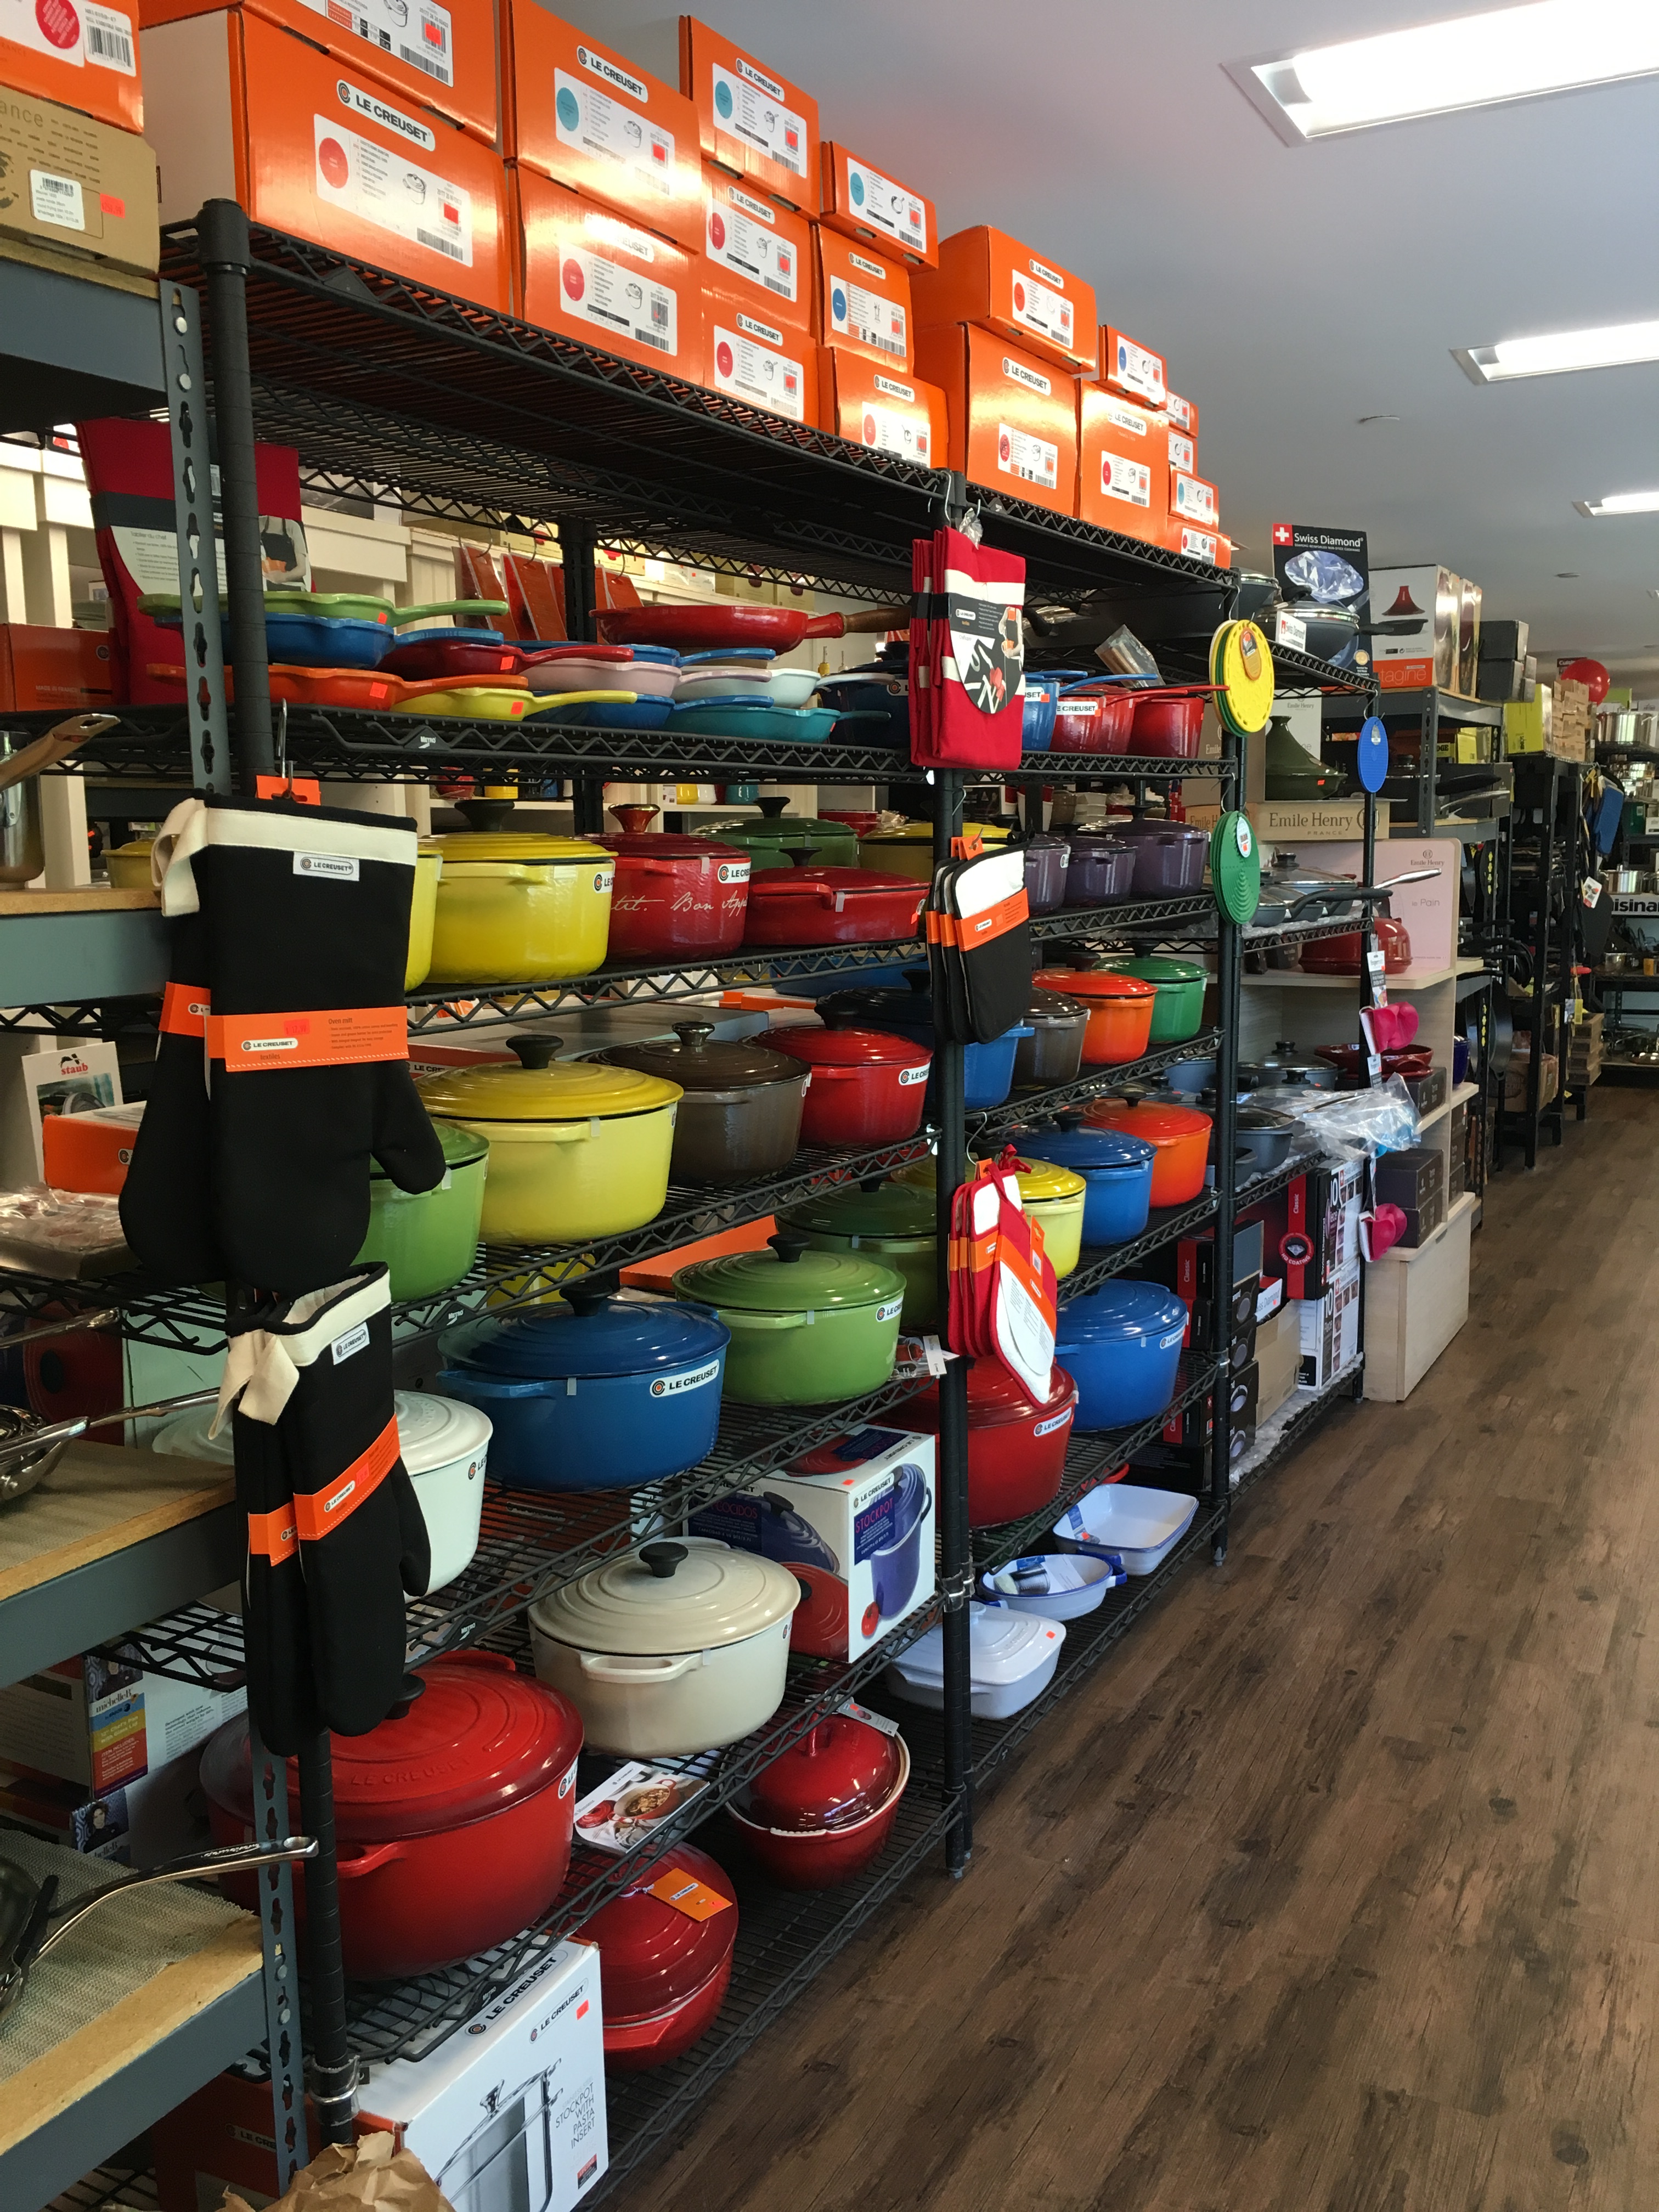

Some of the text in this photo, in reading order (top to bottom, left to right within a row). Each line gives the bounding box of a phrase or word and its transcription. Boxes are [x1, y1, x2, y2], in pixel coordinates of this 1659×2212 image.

[591, 57, 642, 95] LE CREUSET
[745, 67, 781, 97] LE CREUSET
[356, 94, 427, 142] LE CREUSET
[736, 193, 771, 219] LE CREUSET
[856, 257, 883, 275] LE CREUSET
[1036, 265, 1061, 285] LE CREUSET
[745, 320, 779, 341] LE CREUSET
[1012, 365, 1047, 390] LE CREUSET
[882, 380, 911, 398] LE CREUSET
[1115, 413, 1143, 431] LE CREUSET
[1294, 533, 1361, 548] Swiss Diamond
[1380, 668, 1426, 685] tagine
[420, 736, 436, 744] METRO
[1206, 744, 1221, 754] Emile
[1190, 815, 1211, 828] Emile
[1269, 812, 1353, 831] Emile Henry
[322, 863, 348, 871] CREUSET
[604, 878, 610, 887] LE
[670, 891, 714, 912] Bon
[1420, 898, 1440, 907] Pain
[1614, 898, 1659, 912] isina
[61, 1062, 88, 1075] staub
[1281, 1253, 1311, 1265] HD COATING
[887, 1307, 894, 1316] LE
[1325, 1288, 1333, 1318] 10
[448, 1310, 464, 1319] METRO
[348, 1335, 364, 1347] CREUSET
[669, 1365, 717, 1390] LE CREUSET
[478, 1458, 484, 1471] LE
[861, 1477, 891, 1502] LE CREUSET
[855, 1497, 893, 1534] STOCKPOT
[461, 1622, 476, 1634] METRO
[485, 1956, 556, 2020] LE CREUSET
[540, 1984, 584, 2031] LE CREUSET
[555, 2082, 594, 2129] STOCKPOT
[575, 2094, 594, 2118] WITH
[573, 2107, 595, 2134] PASTA
[241, 2130, 252, 2140] LE
[571, 2118, 595, 2149] INSERT
